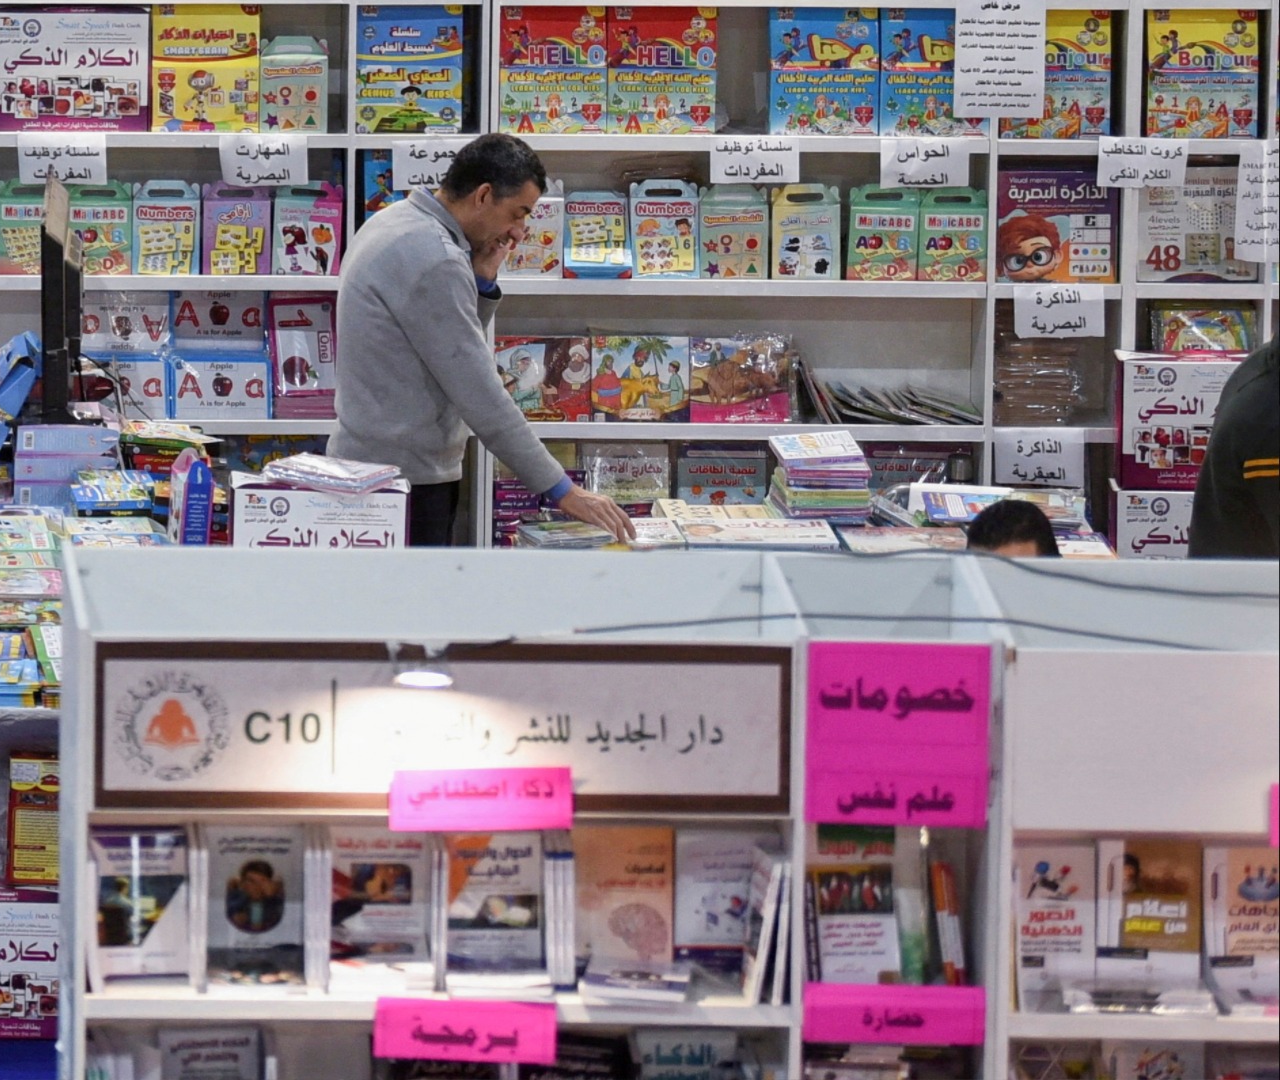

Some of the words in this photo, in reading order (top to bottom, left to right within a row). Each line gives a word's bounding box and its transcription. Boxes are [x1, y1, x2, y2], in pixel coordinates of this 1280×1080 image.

[4, 47, 67, 74] الذكي
[75, 47, 139, 68] الكلام
[528, 44, 605, 66] HELLO
[637, 45, 714, 67] HELLO
[1045, 48, 1105, 66] onjour
[1179, 50, 1252, 67] Bonjour
[25, 145, 61, 161] توظيف
[65, 145, 100, 159] سلسلة
[409, 144, 456, 161] جموعة
[715, 140, 753, 155] توظيف
[756, 140, 792, 153] سلسلة
[897, 144, 949, 162] الحواس
[1102, 144, 1147, 158] التخاطب
[1151, 144, 1183, 158] كروت
[236, 167, 290, 182] البصرية
[724, 163, 784, 179] المفردات
[898, 172, 948, 186] الخمسة
[1109, 168, 1137, 183] الذكي
[1139, 168, 1170, 181] الكلام
[1009, 176, 1029, 184] Visual
[1031, 176, 1057, 185] memory
[1009, 183, 1056, 201] البصرية
[1060, 182, 1107, 200] الذاكرة
[139, 206, 194, 220] Numbers
[567, 202, 623, 215] Numbers
[637, 203, 694, 216] Numbers
[1146, 244, 1180, 271] 48
[1036, 290, 1081, 307] الذاكرة
[1031, 315, 1087, 332] البصرية
[1138, 395, 1204, 424] الذكي
[1017, 440, 1061, 457] الذاكرة
[1012, 465, 1065, 482] العبقرية
[820, 677, 974, 719] خصومات
[245, 711, 320, 745] C10
[510, 713, 571, 754] للنشر
[587, 714, 666, 752] الجديد
[681, 719, 722, 754] دار
[407, 778, 508, 807] اصطناعي
[516, 781, 554, 800] ذكاء
[837, 783, 896, 814] نفس
[906, 785, 955, 816] علم
[411, 1015, 518, 1052] برمجة
